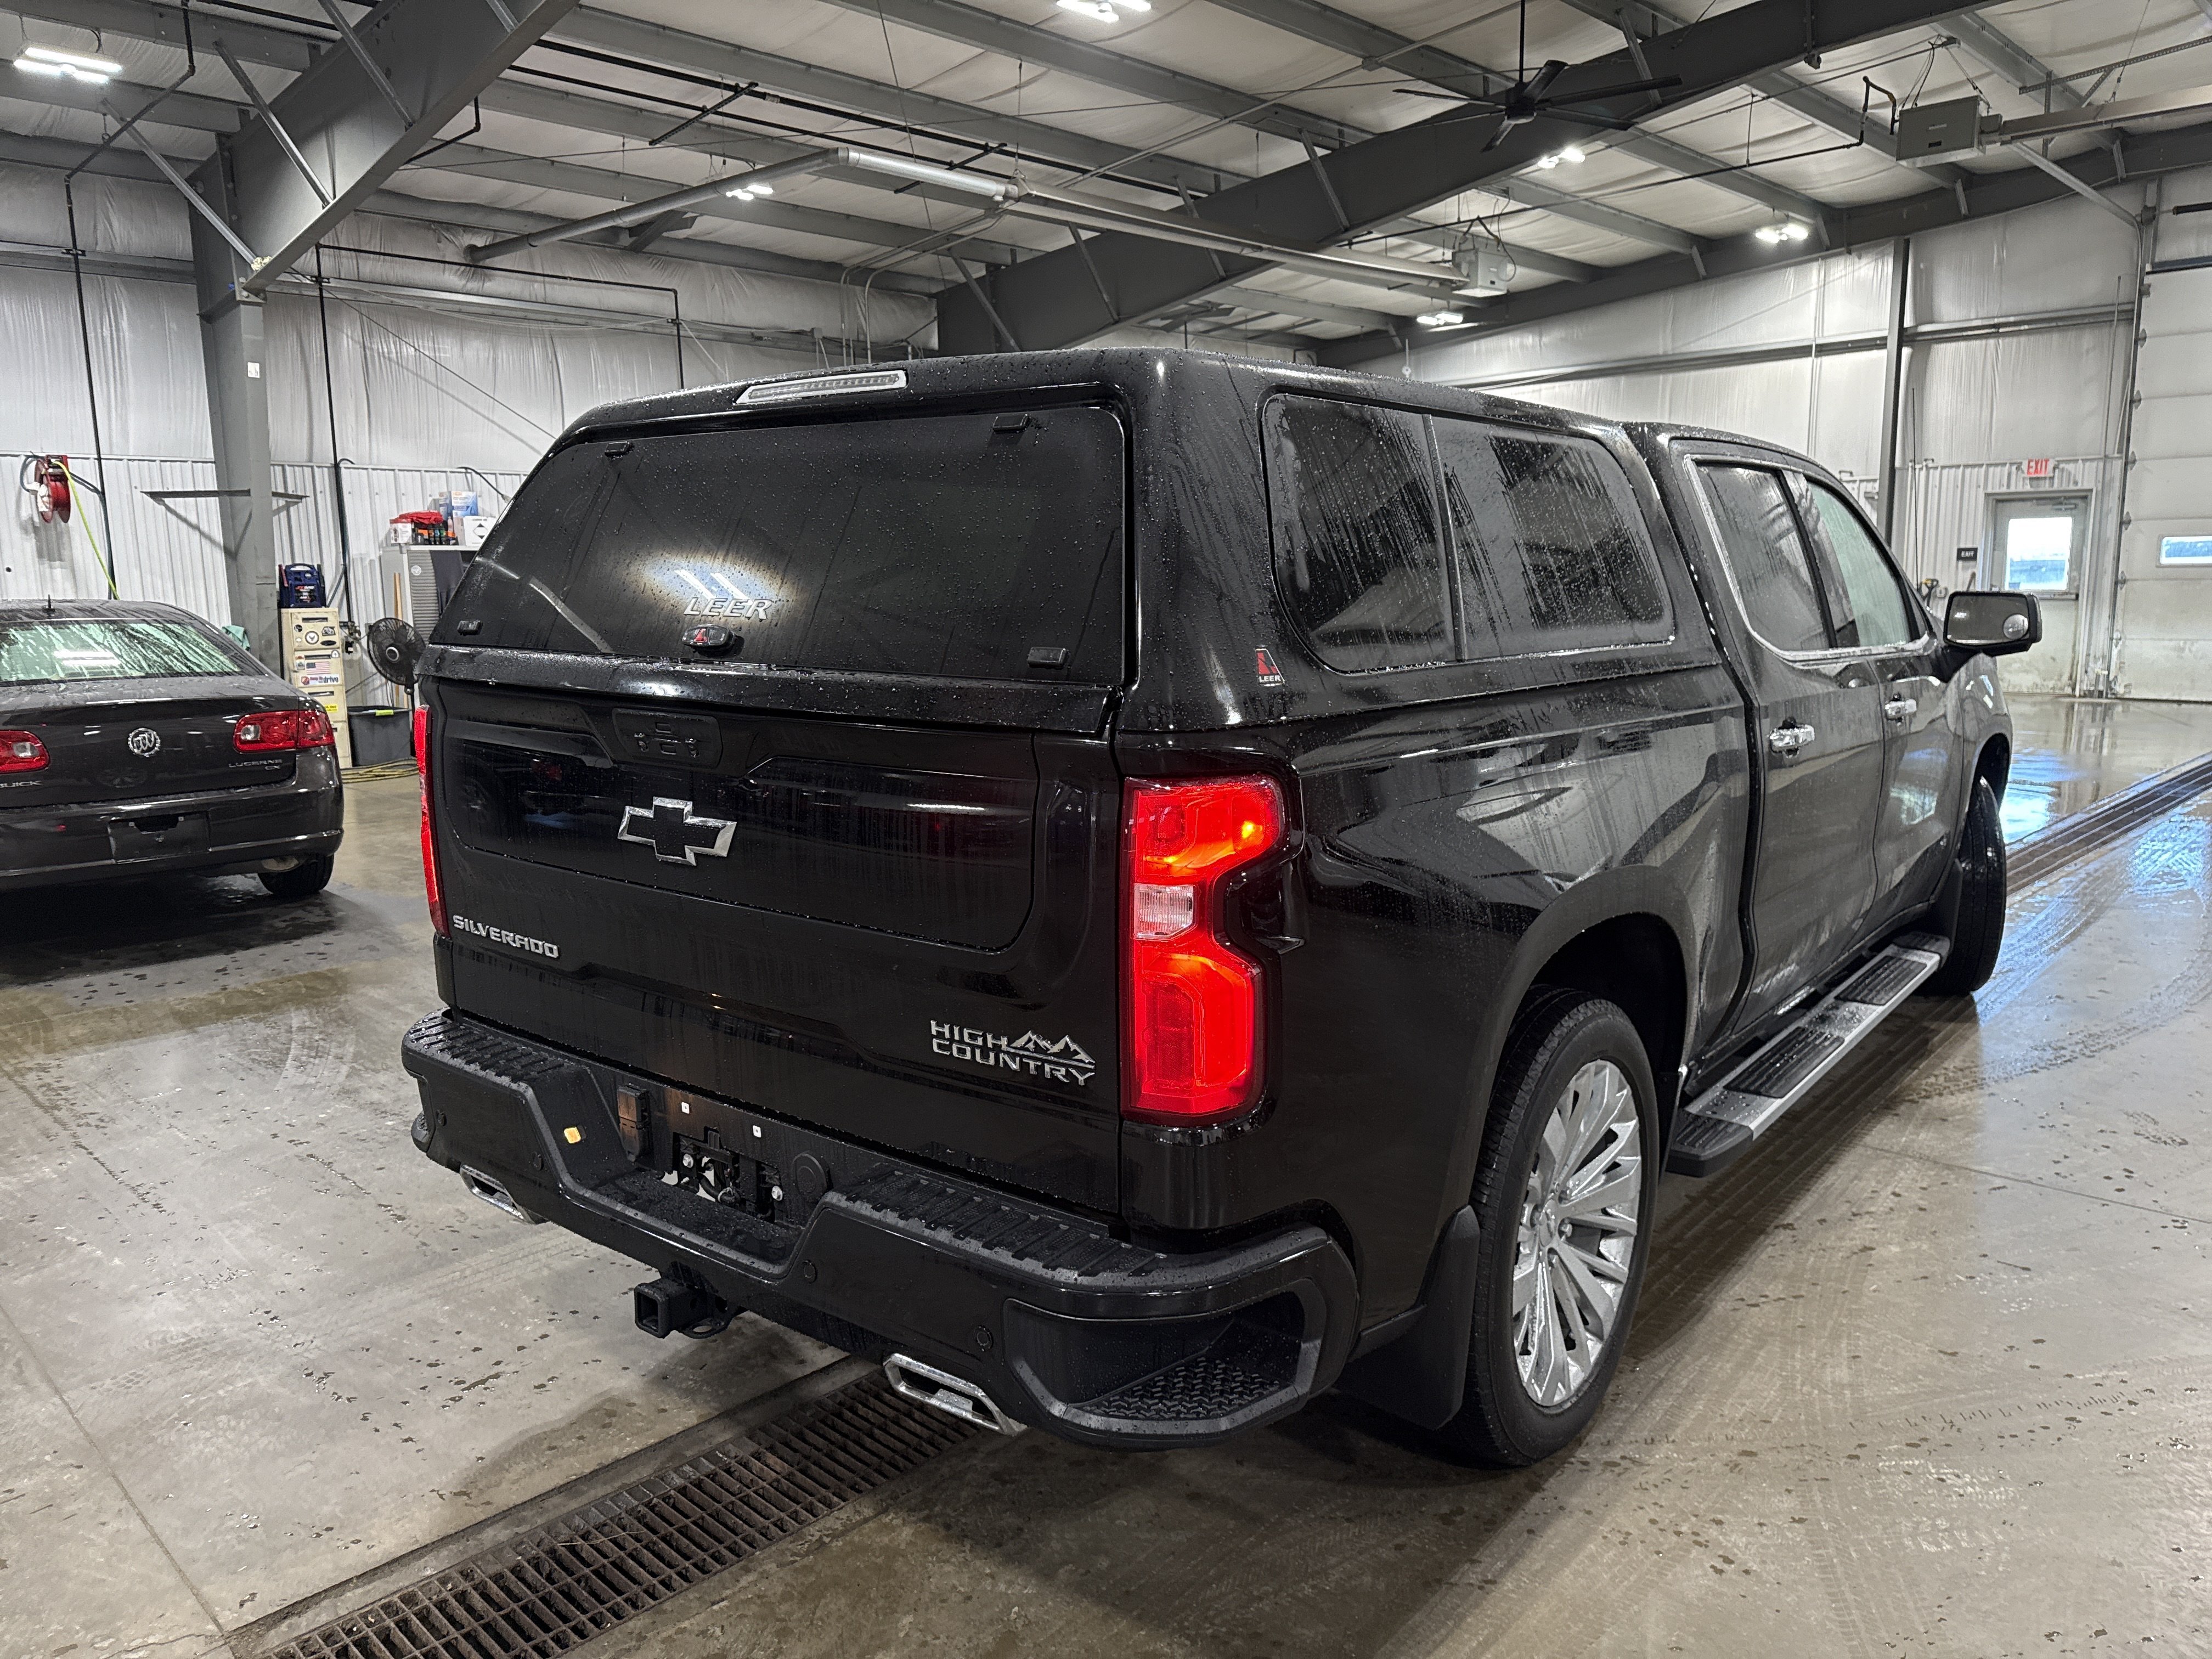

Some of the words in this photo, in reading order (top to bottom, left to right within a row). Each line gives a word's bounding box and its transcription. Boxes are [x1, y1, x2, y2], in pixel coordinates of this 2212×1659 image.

[2027, 458, 2050, 476] EXIT
[684, 596, 774, 620] LEER
[228, 759, 283, 768] LUCERNE
[453, 914, 560, 959] SILVERADO
[930, 1019, 1008, 1049] HIGH
[932, 1038, 1096, 1086] COUNTRY
